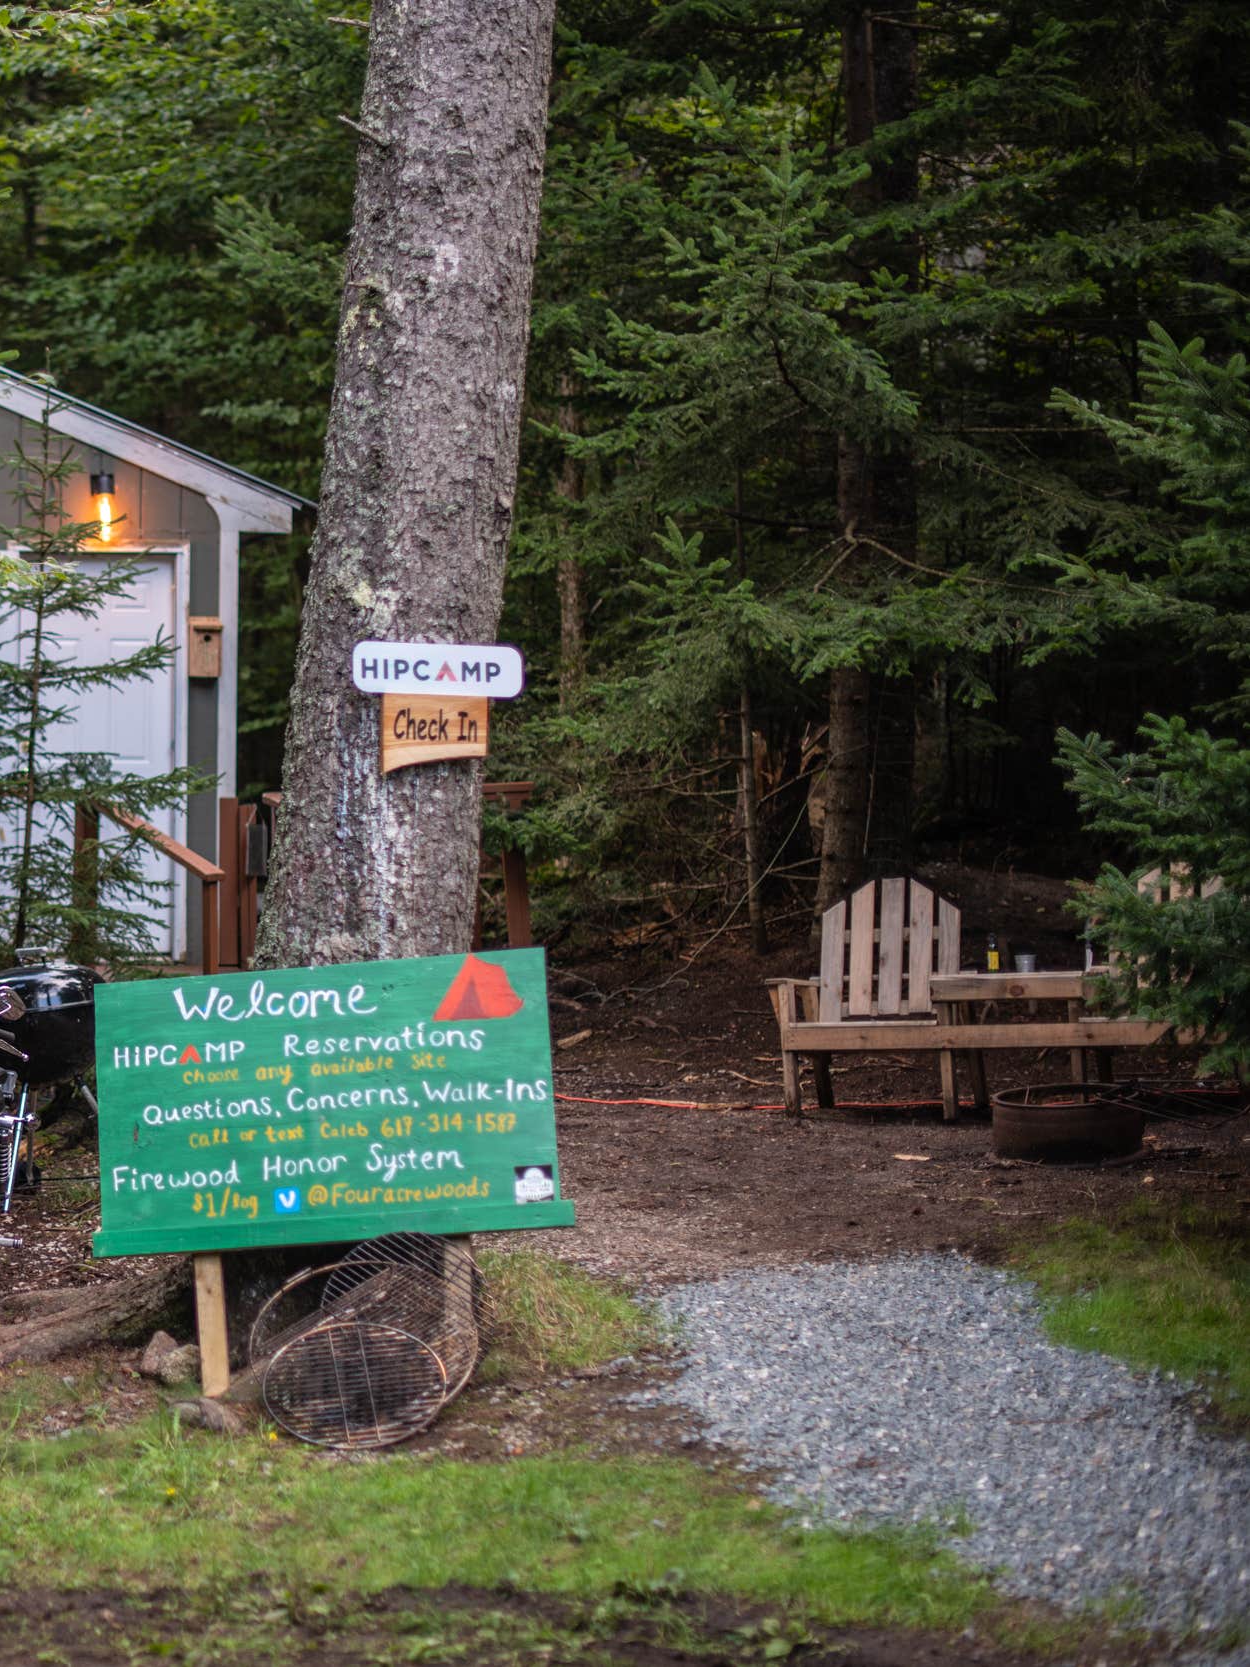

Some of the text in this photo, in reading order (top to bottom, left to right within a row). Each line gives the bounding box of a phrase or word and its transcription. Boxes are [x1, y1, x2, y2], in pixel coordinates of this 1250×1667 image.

[361, 658, 501, 683] HIPCAMP
[393, 708, 478, 742] Check In
[172, 980, 377, 1021] Welcome
[284, 1022, 485, 1057] Reservations
[255, 1064, 293, 1085] any
[310, 1056, 394, 1077] available
[422, 1078, 547, 1103] Walk-Ins
[240, 1129, 257, 1142] or
[265, 1125, 304, 1143] text
[320, 1122, 369, 1139] Caleb
[112, 1143, 464, 1192] Firewood Honor System
[192, 1186, 259, 1219] $1/log
[307, 1176, 490, 1207] @Fouracrewoods
